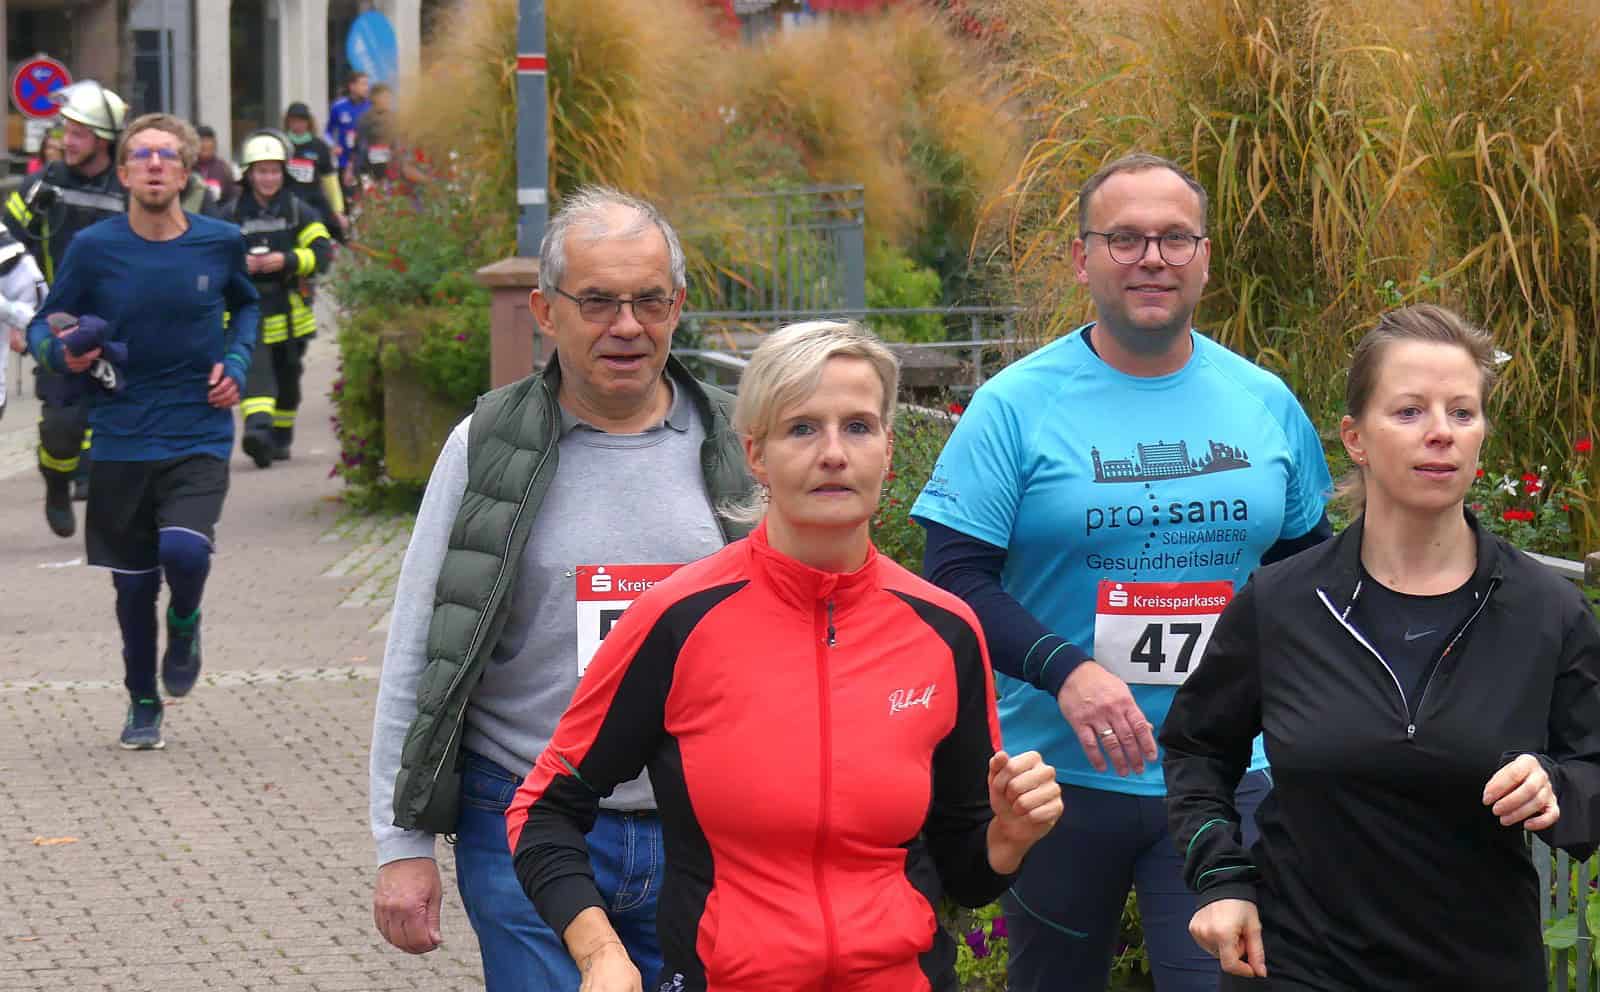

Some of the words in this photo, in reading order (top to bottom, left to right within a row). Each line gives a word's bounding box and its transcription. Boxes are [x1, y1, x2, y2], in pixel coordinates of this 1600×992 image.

[1162, 529, 1247, 545] SCHRAMBERG
[1086, 550, 1243, 571] Gesundheitslauf
[1133, 594, 1227, 609] Kreissparkasse
[1130, 623, 1203, 673] 47
